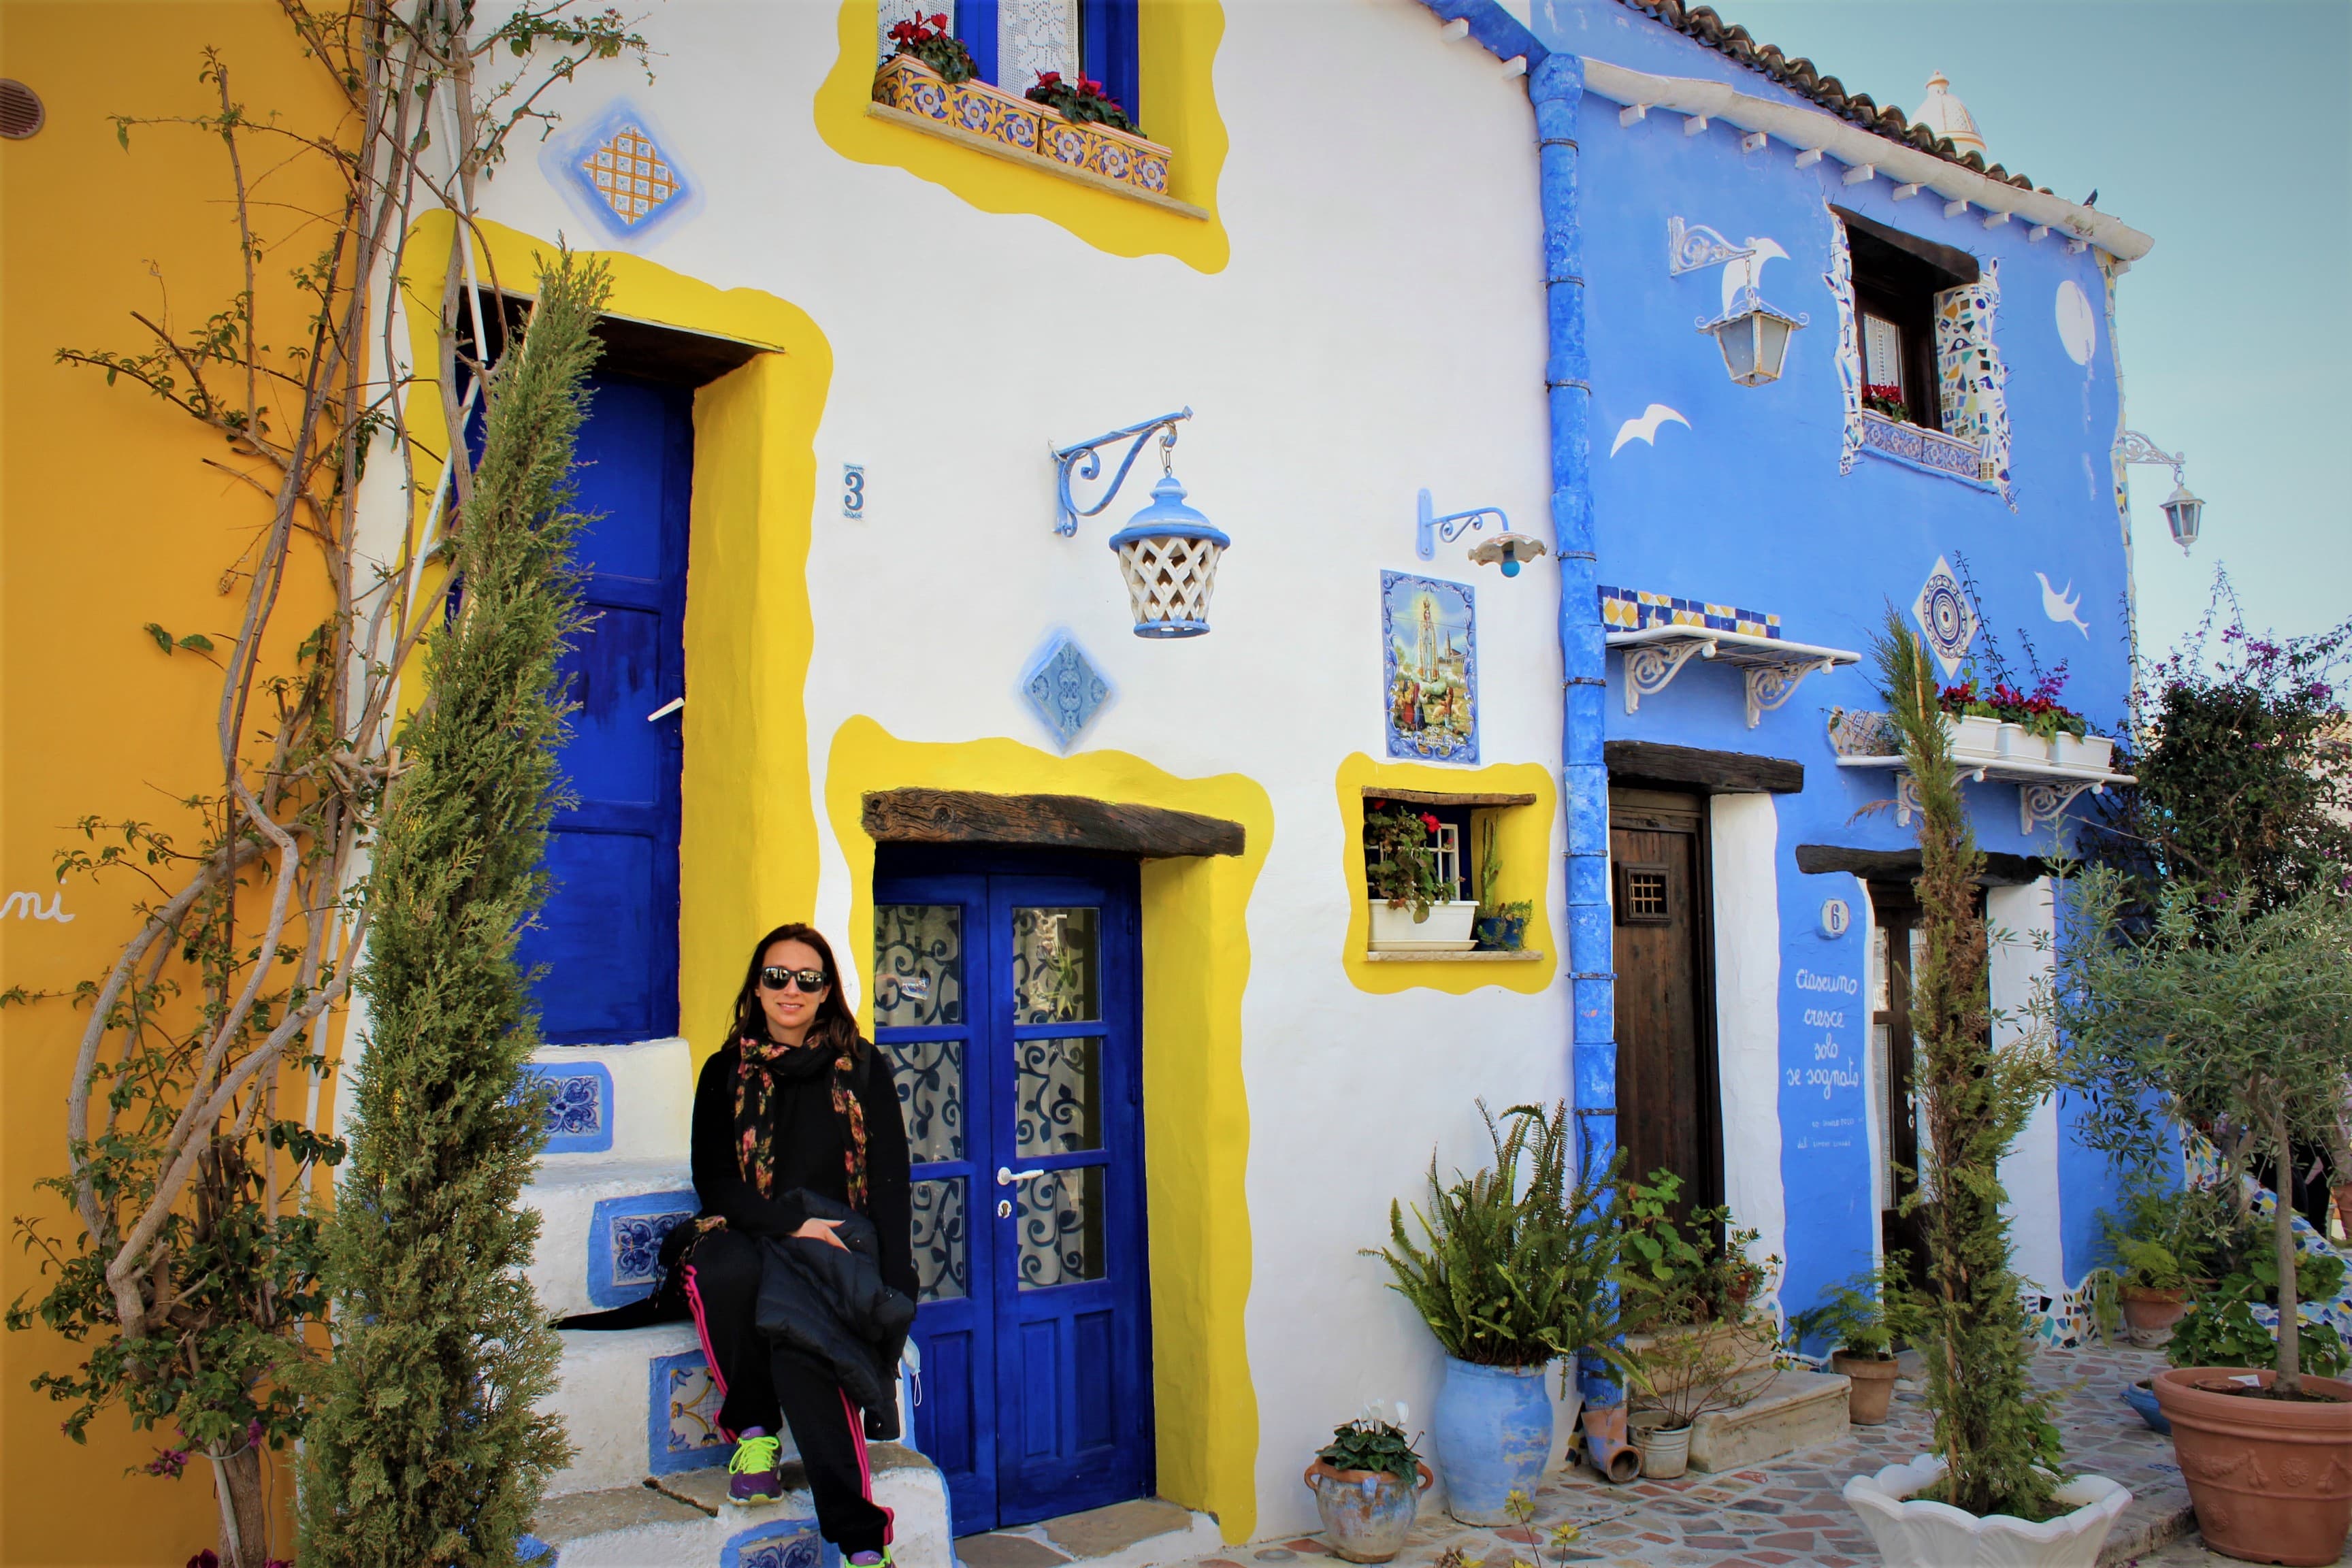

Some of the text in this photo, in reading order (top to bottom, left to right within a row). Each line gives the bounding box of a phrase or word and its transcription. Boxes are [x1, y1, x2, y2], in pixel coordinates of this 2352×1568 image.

[845, 472, 864, 510] 3
[1831, 904, 1840, 930] 6
[1803, 1008, 1844, 1028] cresce
[1814, 1032, 1838, 1060] solo
[1786, 1067, 1801, 1085] se
